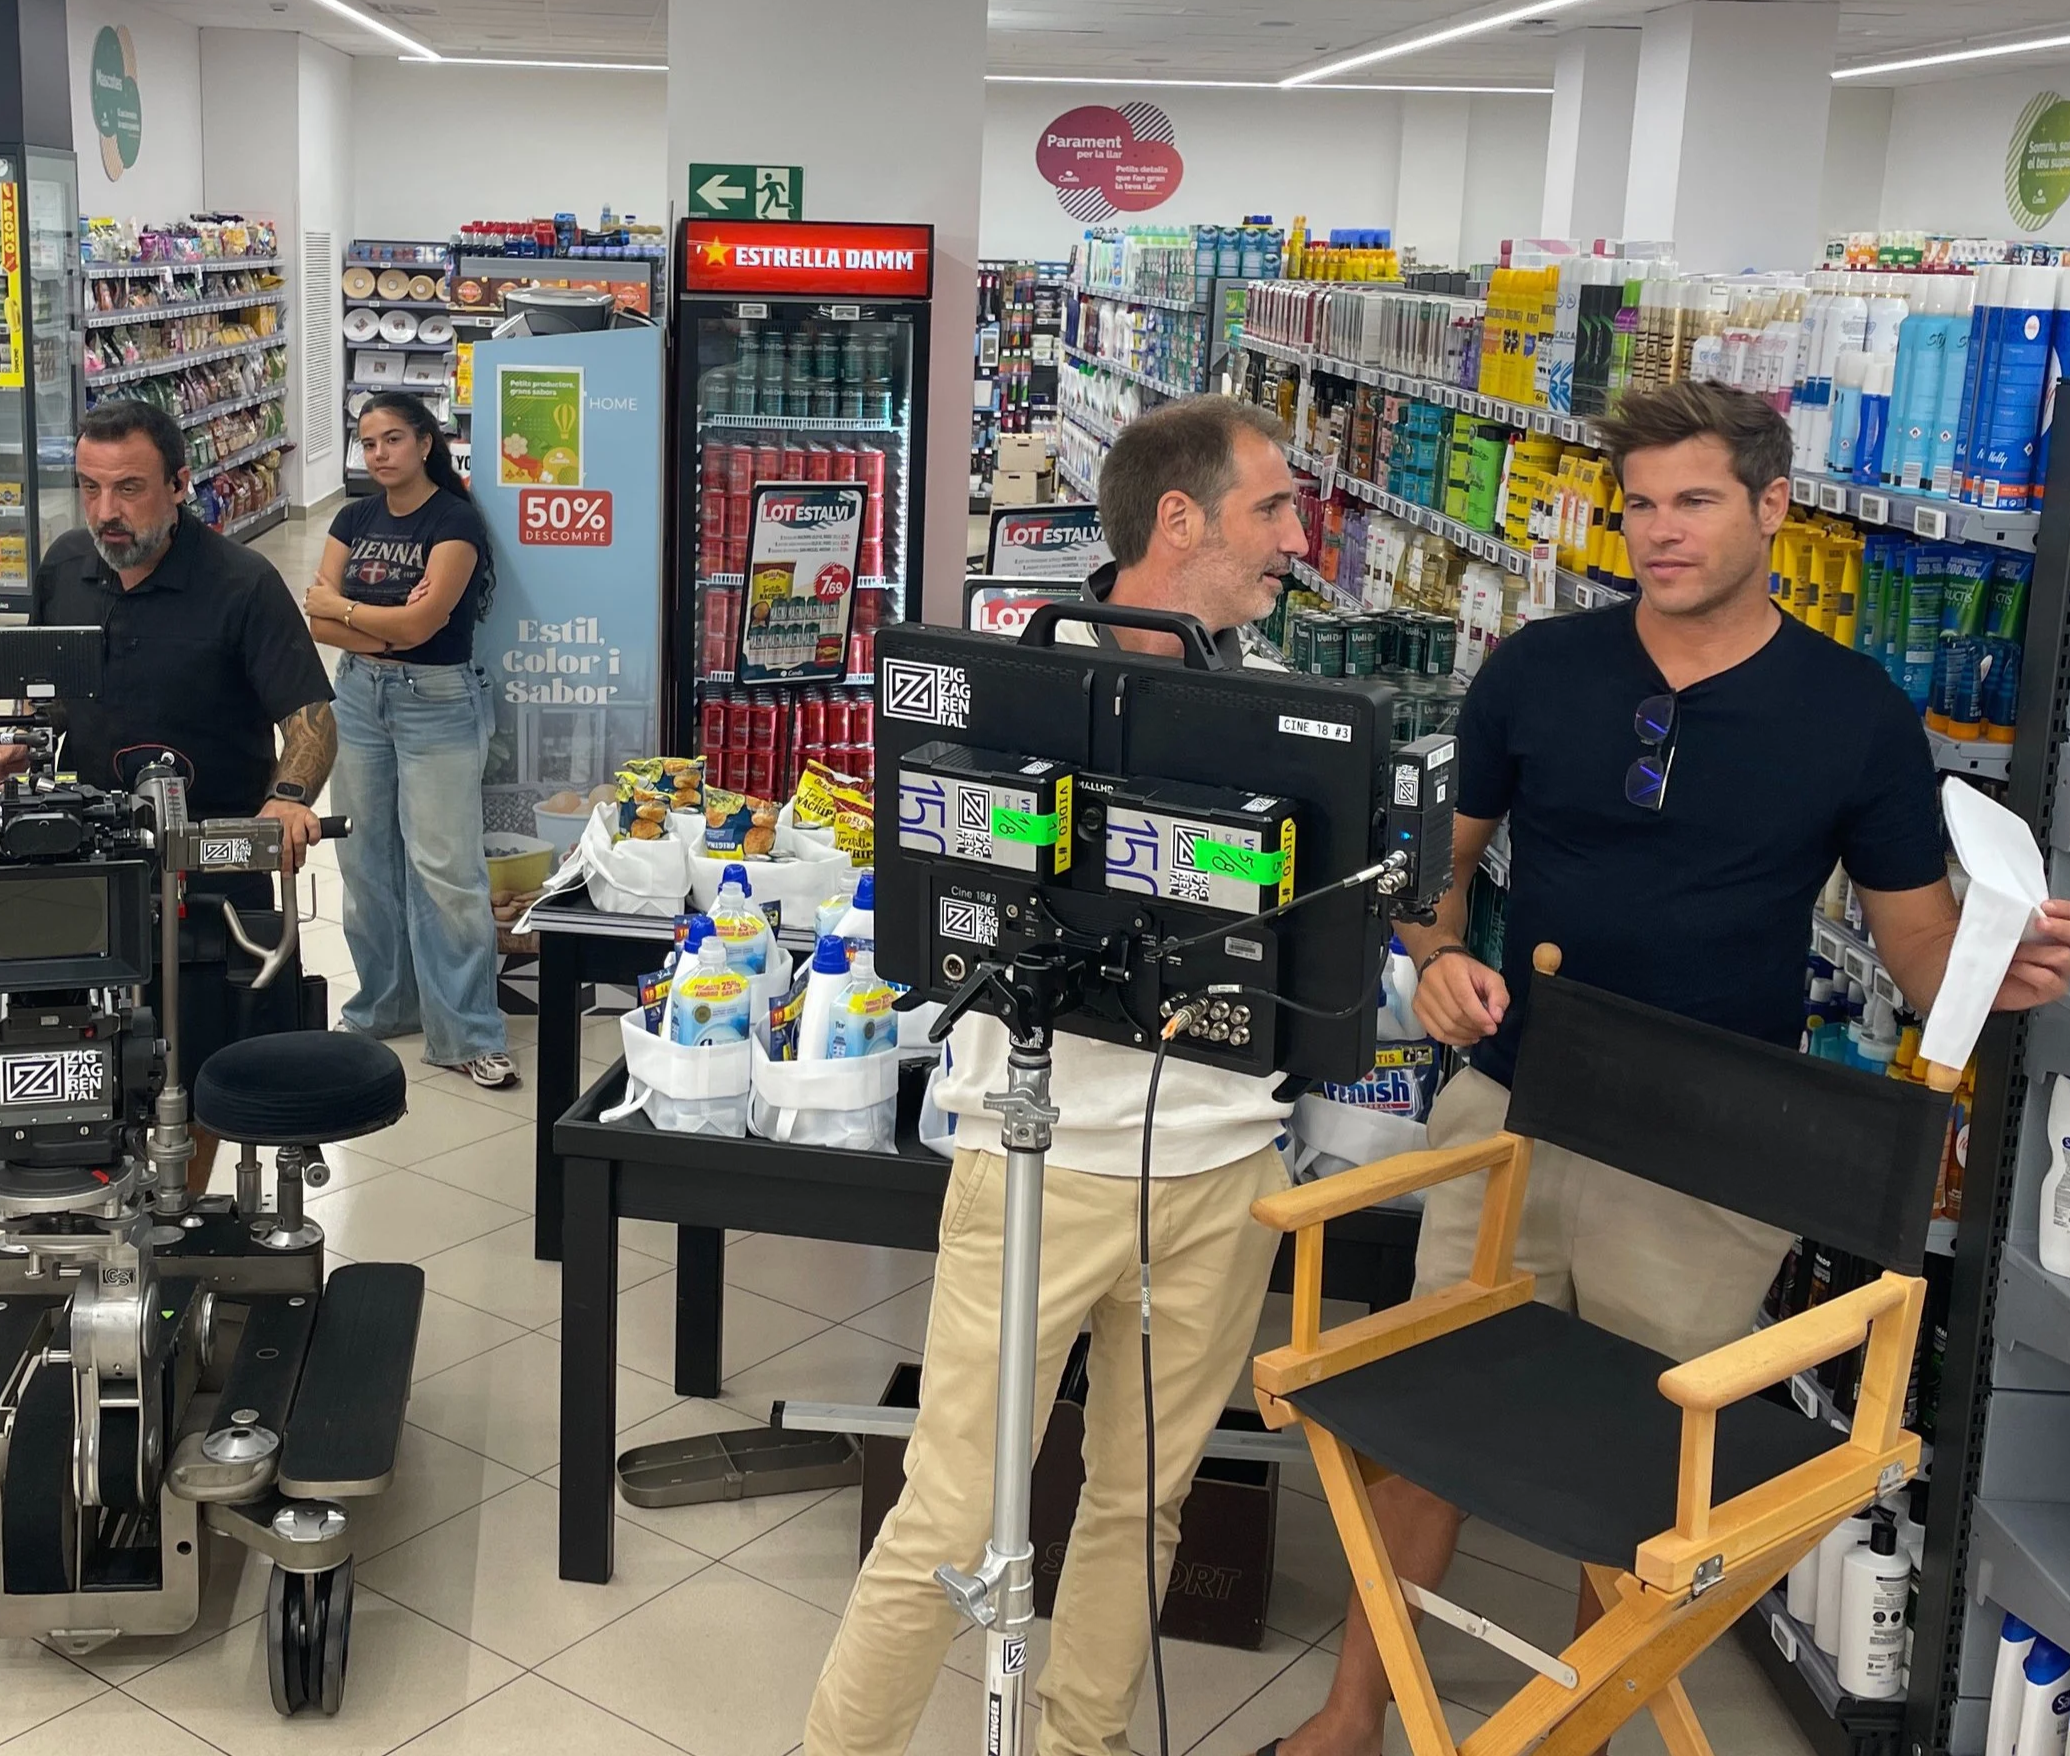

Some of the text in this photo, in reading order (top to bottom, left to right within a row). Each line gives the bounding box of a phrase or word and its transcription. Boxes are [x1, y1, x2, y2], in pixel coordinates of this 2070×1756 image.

[1047, 134, 1122, 149] Parament
[1076, 150, 1122, 160] per la llar
[1115, 174, 1165, 184] que fan gran
[3, 200, 15, 253] PROMO
[735, 246, 914, 271] ESTRELLA DAMM
[509, 379, 532, 388] Petits
[509, 388, 531, 397] grans
[589, 397, 638, 412] HOME
[526, 496, 606, 531] 50%
[761, 504, 850, 523] LOT ESTALVI
[526, 530, 606, 543] DESCOMPTE
[1002, 527, 1042, 547] LOT
[350, 537, 425, 569] VIENNA
[1944, 588, 1973, 603] RUCTIS
[518, 616, 606, 646] Estil,
[502, 646, 621, 675] Color i
[941, 665, 966, 682] ZIG
[504, 677, 619, 705] Sabor
[941, 681, 971, 699] ZAG
[941, 697, 970, 714] REN
[941, 713, 967, 729] TAL
[1284, 719, 1349, 739] CINE 18 #3
[1077, 780, 1114, 795] MALLHD
[1058, 785, 1069, 836] VIDEO
[951, 885, 973, 899] Cine
[978, 905, 995, 917] ZIG
[978, 915, 999, 928] ZAG
[978, 925, 998, 937] REN
[978, 935, 996, 947] TAL
[68, 1050, 96, 1063] ZIG
[1377, 1054, 1395, 1063] TIS
[68, 1063, 103, 1078] ZAG
[68, 1077, 102, 1091] REN
[68, 1090, 99, 1101] TAL
[989, 1700, 1000, 1755] AVENGER
